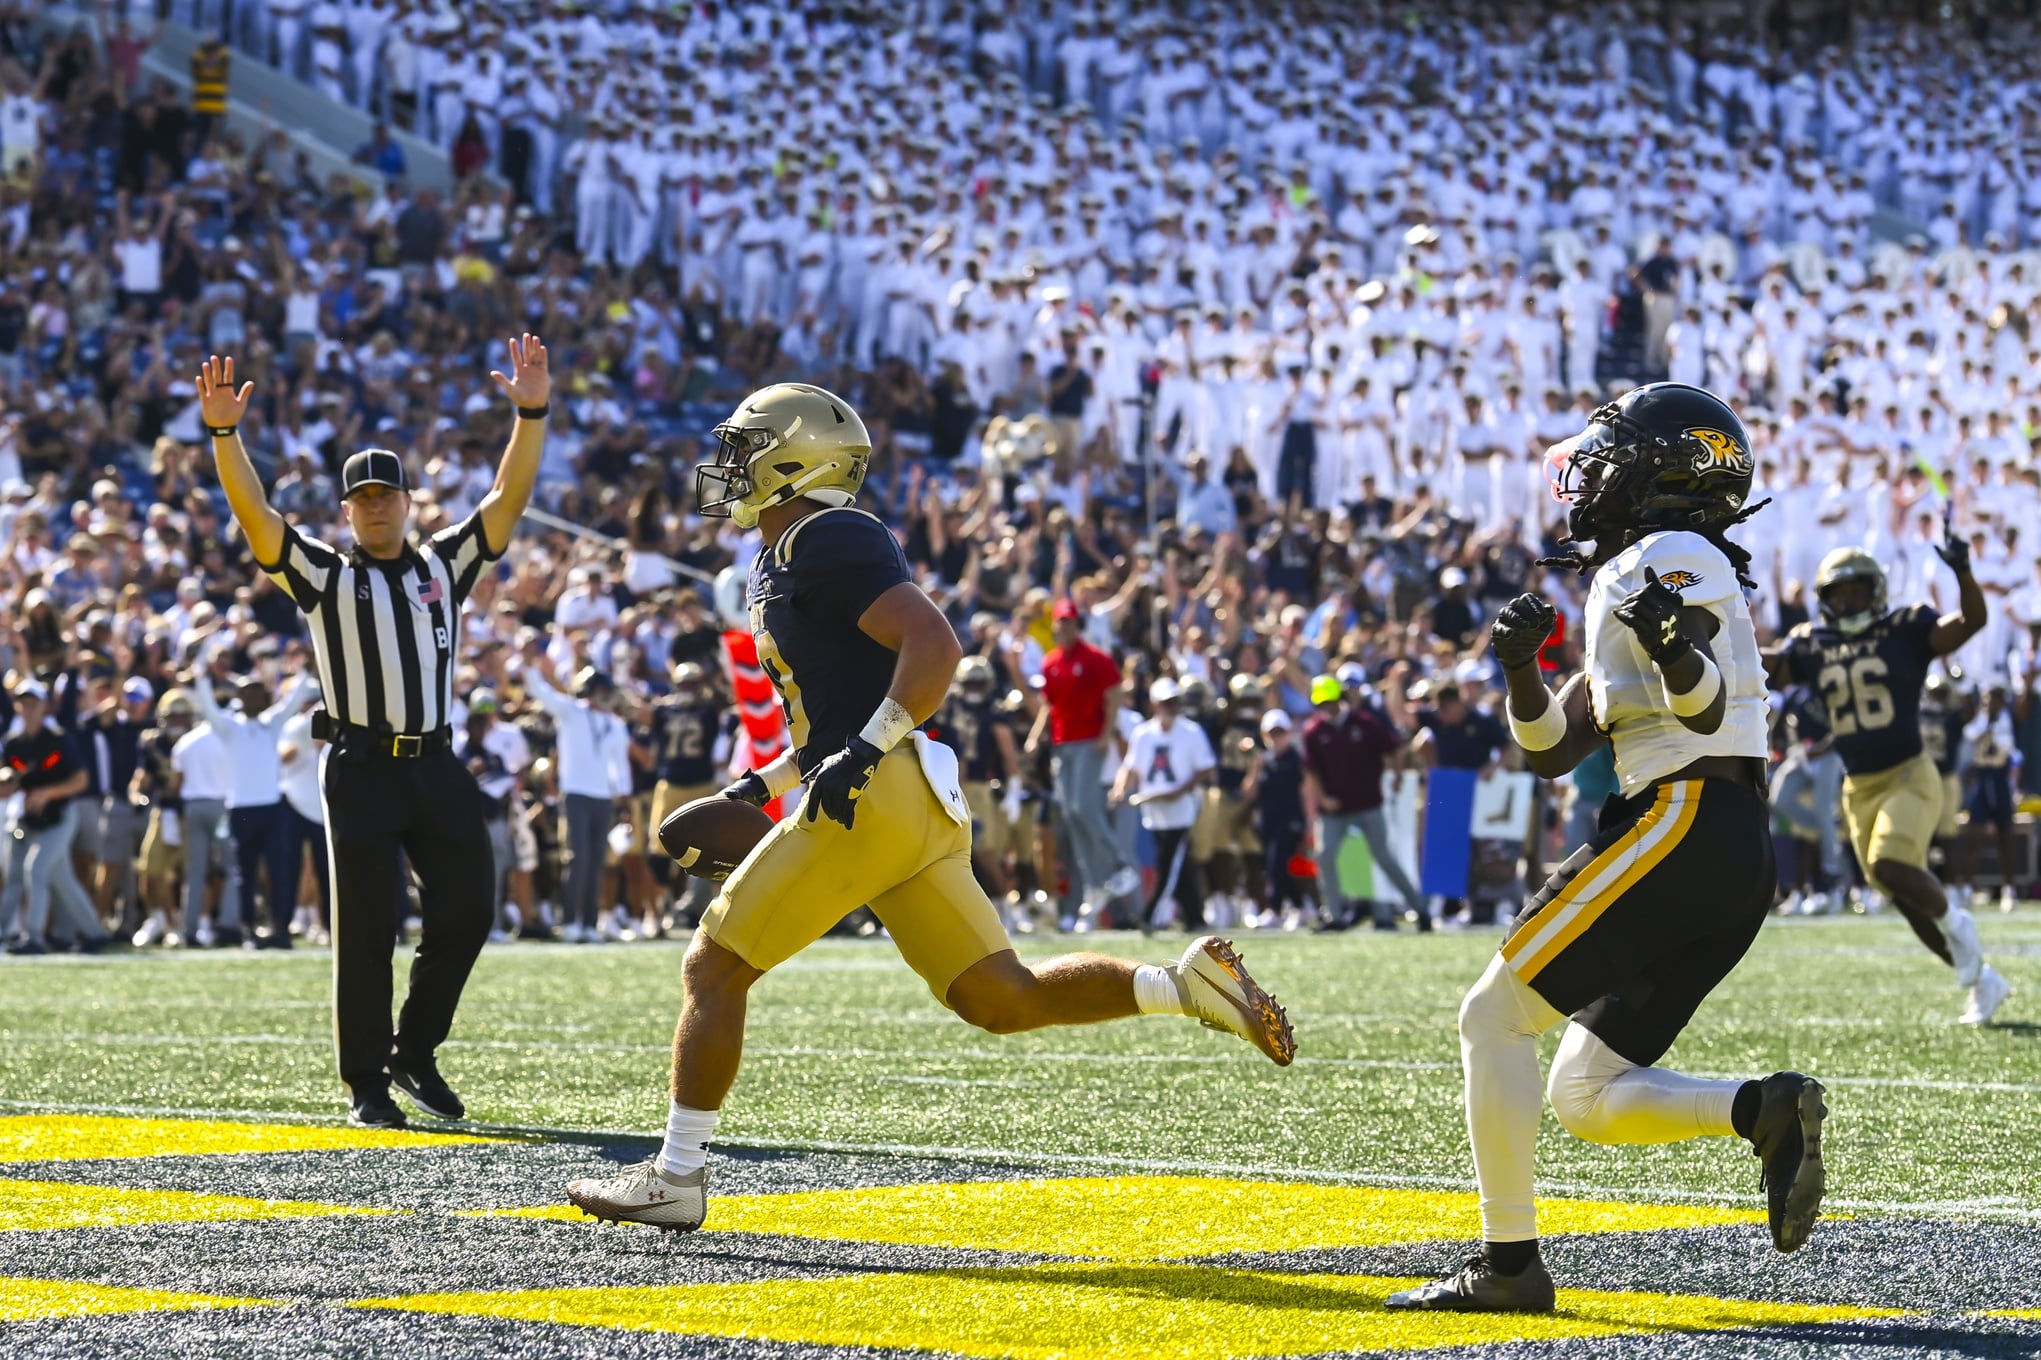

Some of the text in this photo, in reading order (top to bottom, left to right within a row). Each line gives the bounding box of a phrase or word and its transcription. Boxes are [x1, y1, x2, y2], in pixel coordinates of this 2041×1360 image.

[358, 585, 370, 600] S
[435, 627, 448, 649] B
[1824, 639, 1879, 664] NAVY
[1819, 658, 1895, 735] 26
